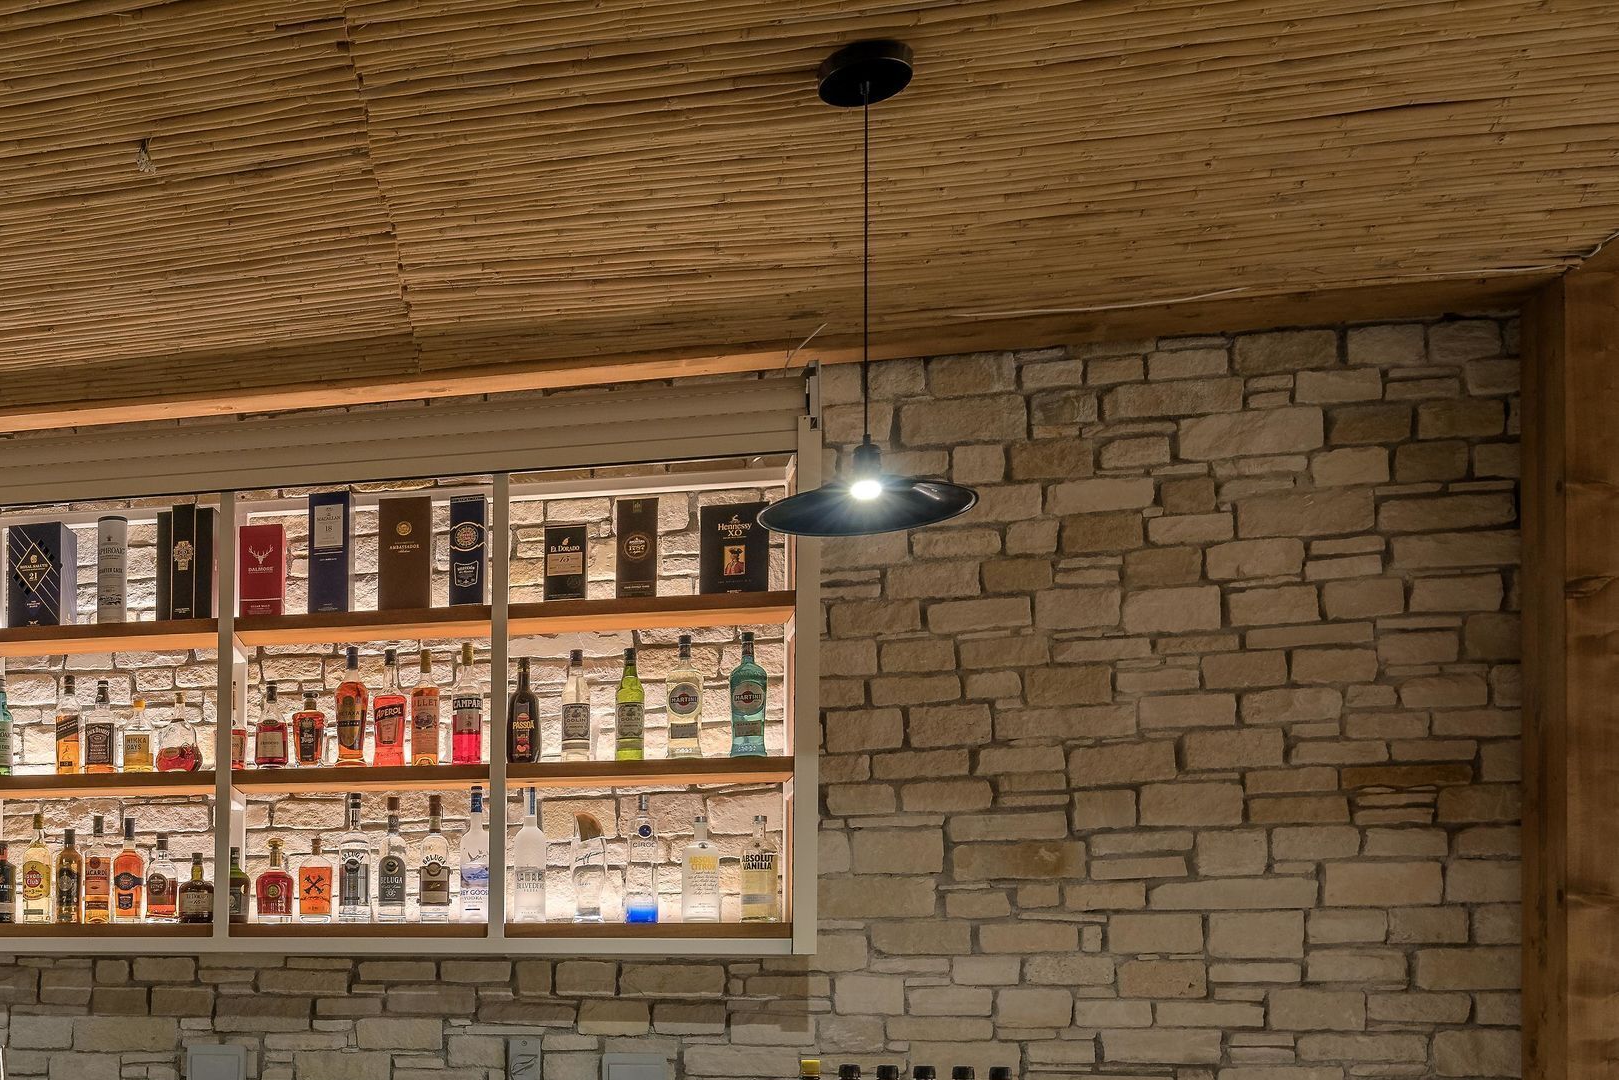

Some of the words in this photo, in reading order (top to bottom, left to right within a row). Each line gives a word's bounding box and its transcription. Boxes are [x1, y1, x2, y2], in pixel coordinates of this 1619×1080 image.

[717, 521, 752, 532] Hennessy
[28, 572, 38, 581] 21
[734, 693, 762, 701] MARTINI
[376, 706, 401, 719] APEROL
[741, 854, 774, 863] ABSOLUT
[743, 862, 772, 871] VANILIA
